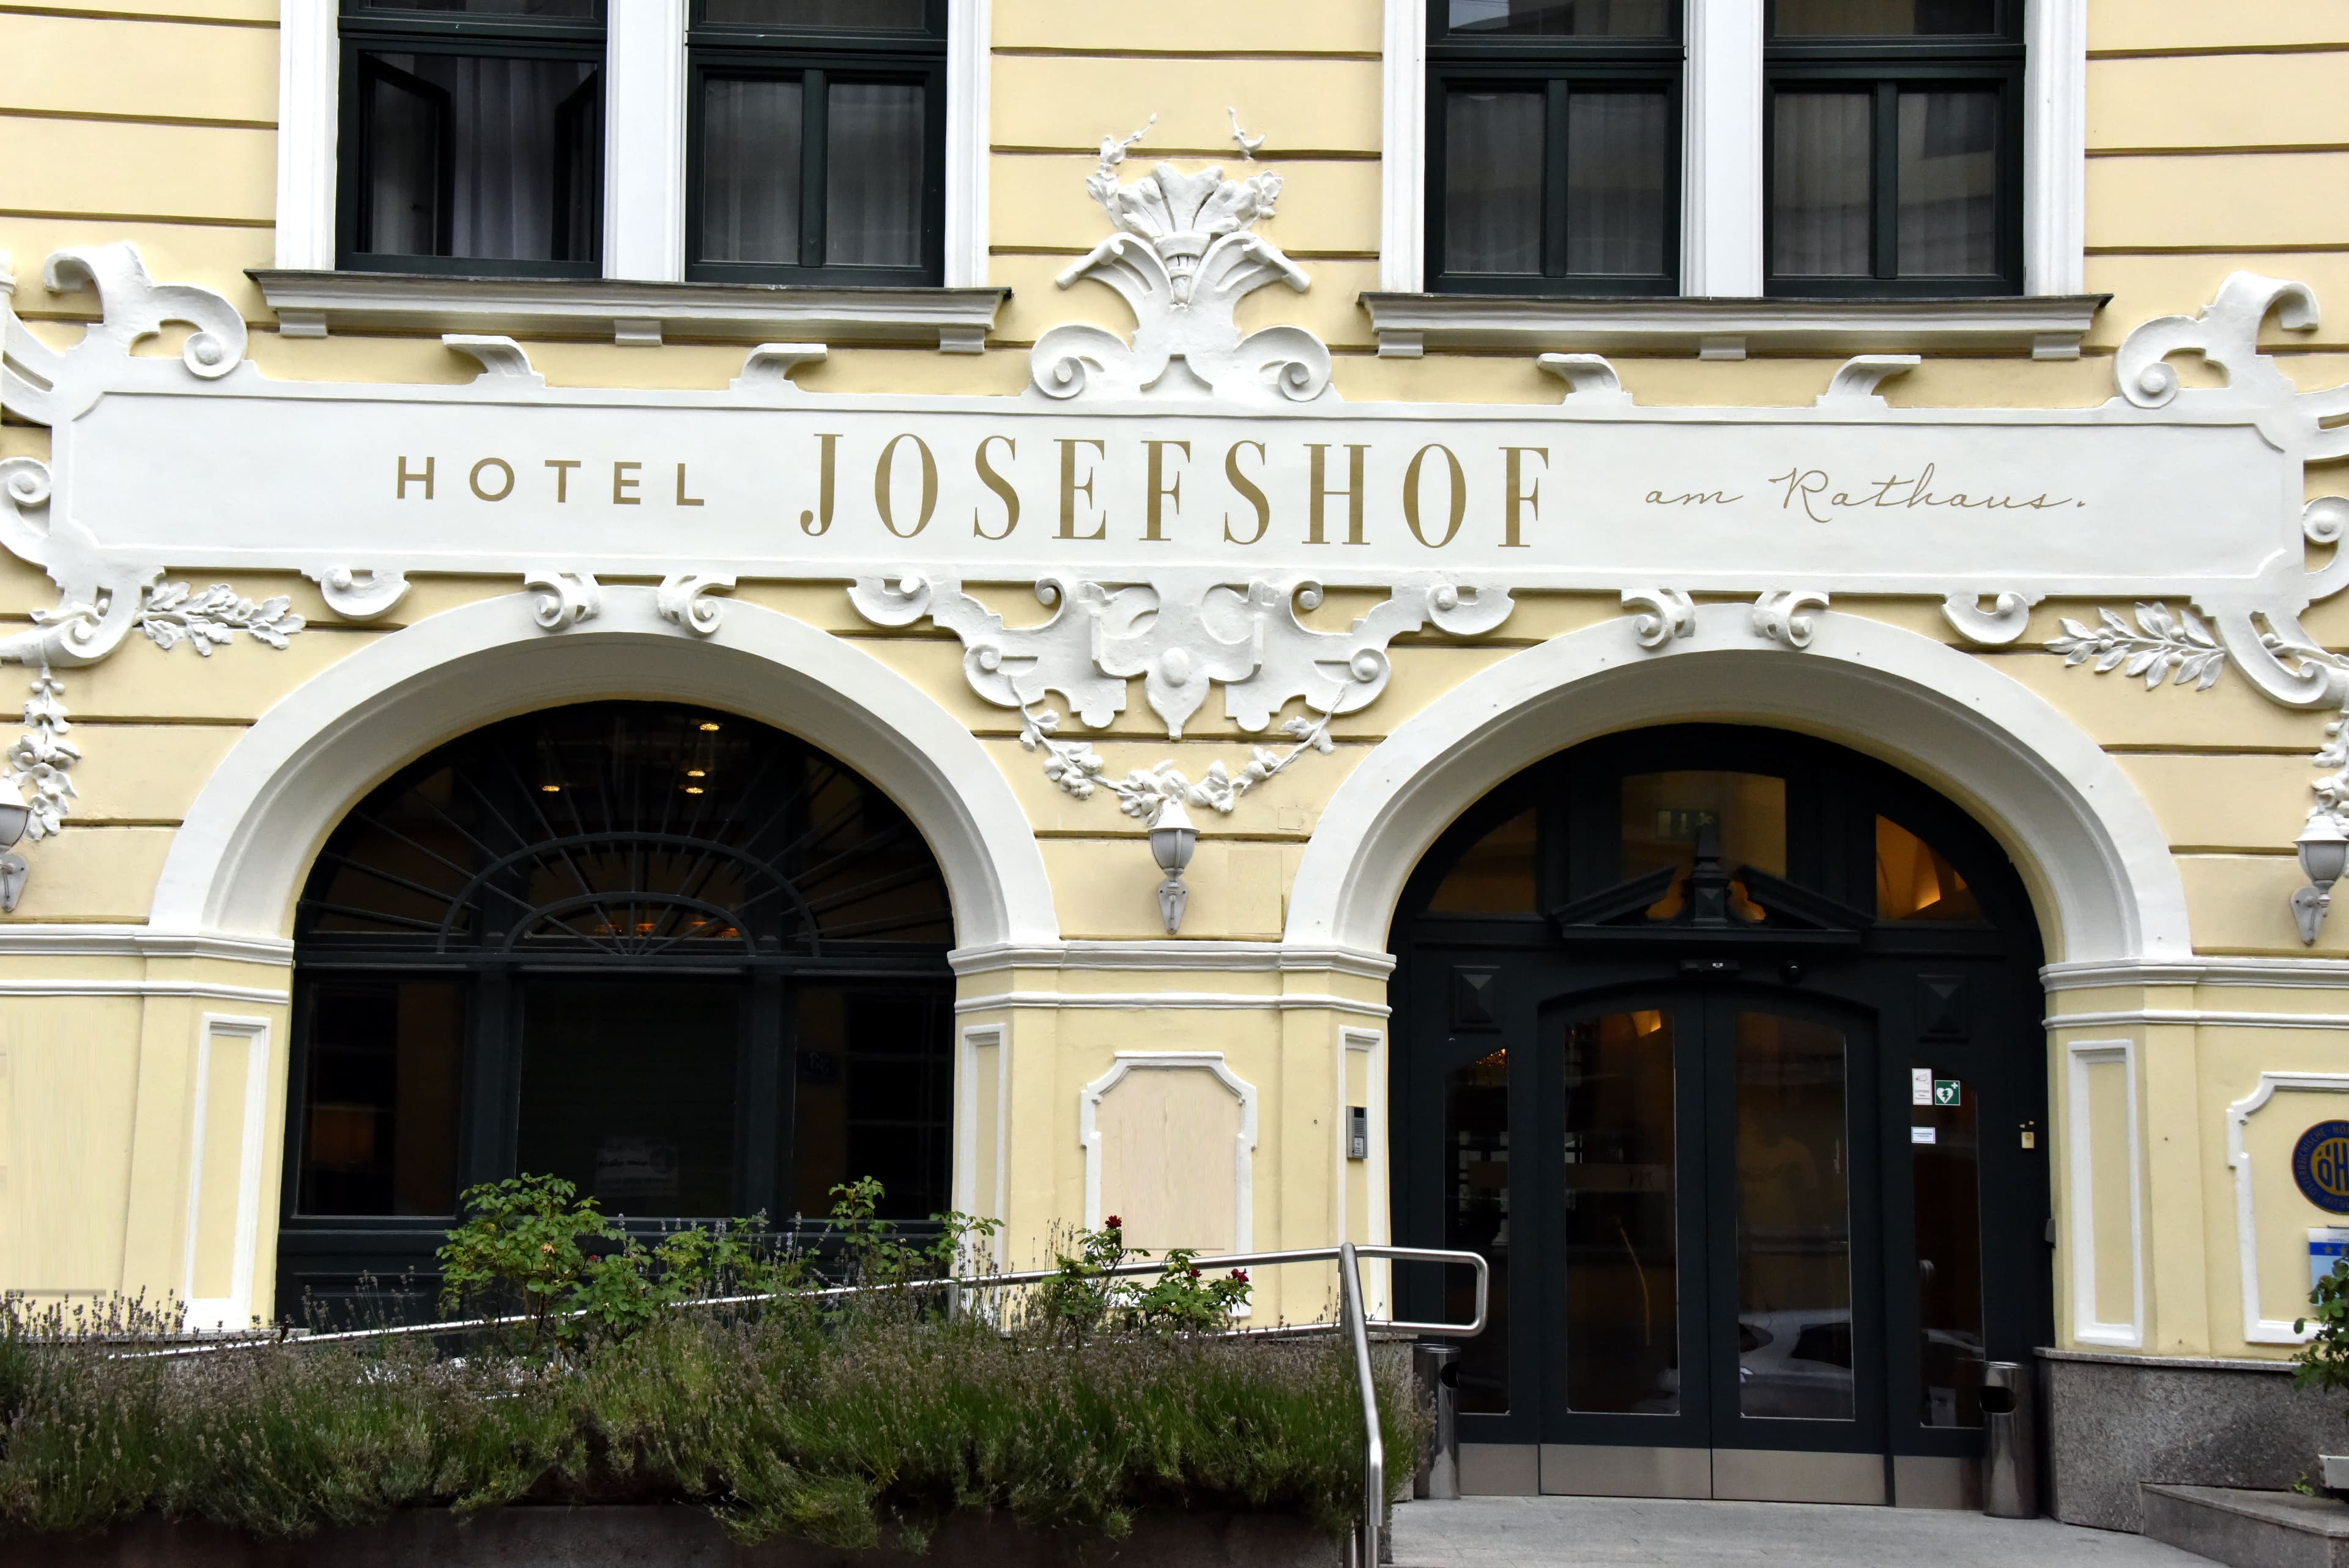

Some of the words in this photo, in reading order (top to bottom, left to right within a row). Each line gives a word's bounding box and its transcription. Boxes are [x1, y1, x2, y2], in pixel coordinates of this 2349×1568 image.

[396, 456, 705, 507] HOTEL
[800, 433, 1549, 549] JOSEFSHOF
[1646, 490, 1743, 505] am
